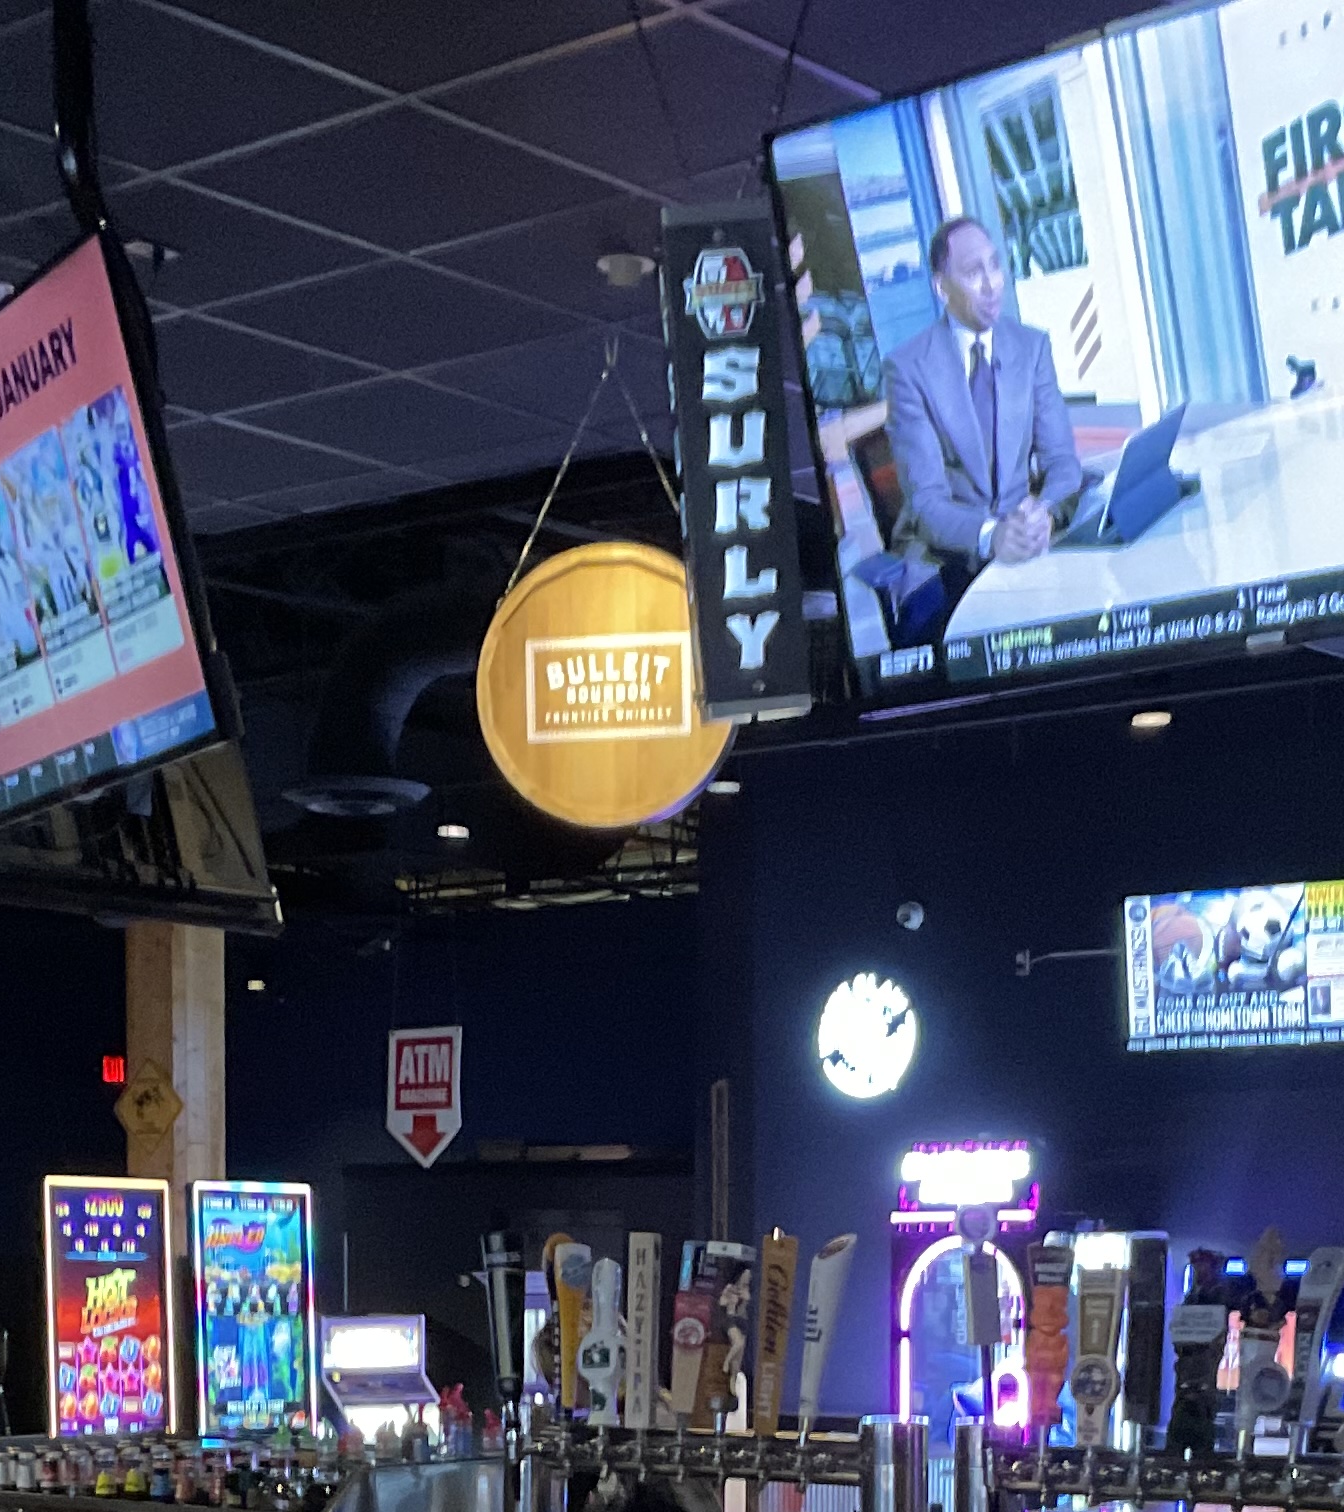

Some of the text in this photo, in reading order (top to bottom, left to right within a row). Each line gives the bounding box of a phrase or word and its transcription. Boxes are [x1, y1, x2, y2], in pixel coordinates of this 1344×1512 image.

[701, 348, 779, 671] SURLY
[991, 626, 1052, 653] Lightning
[546, 651, 671, 690] BULLEIT
[567, 682, 651, 705] BOURBON
[398, 1044, 450, 1084] ATM
[86, 1268, 137, 1310] HOT
